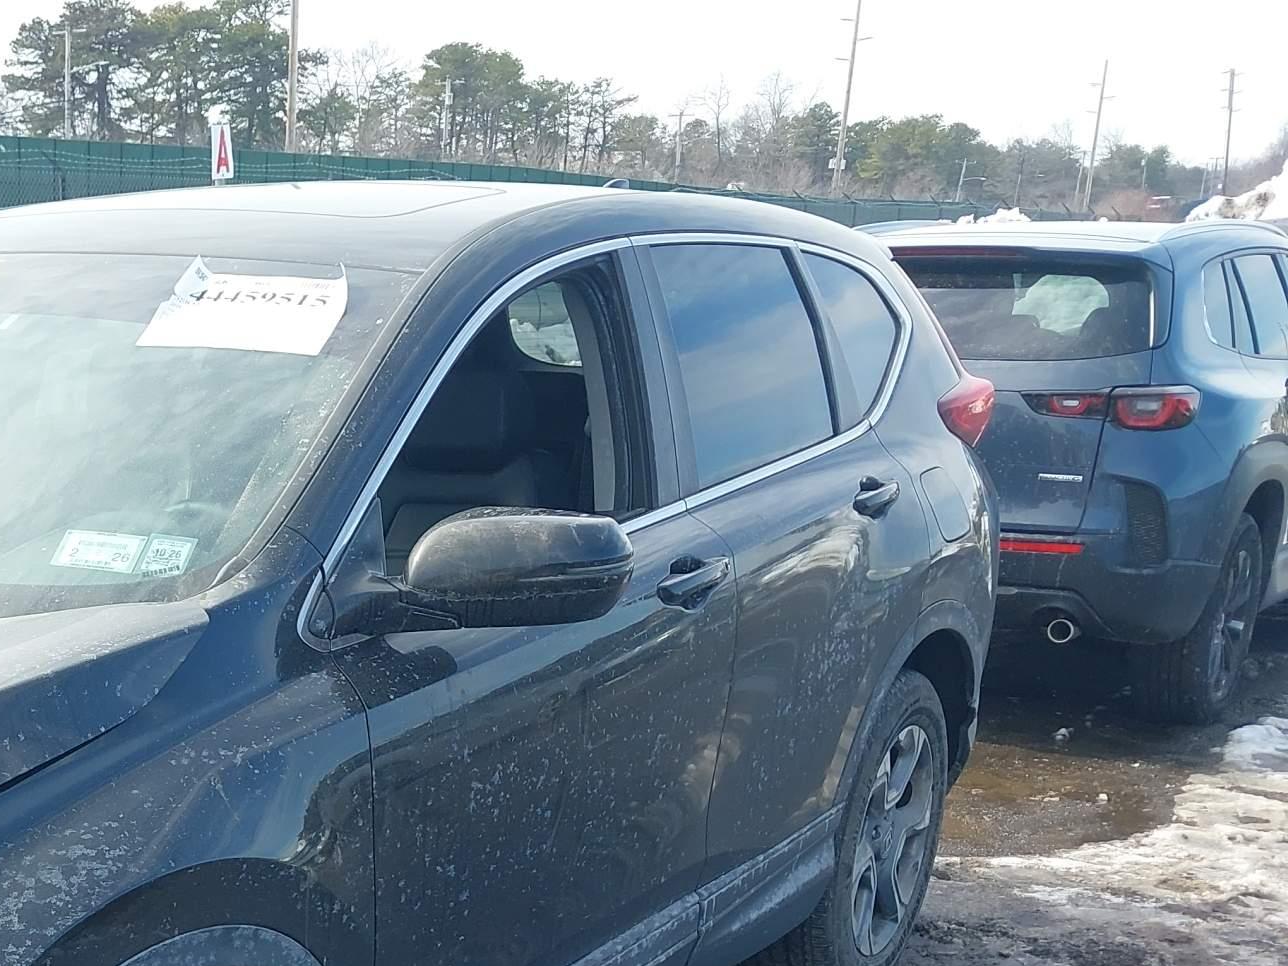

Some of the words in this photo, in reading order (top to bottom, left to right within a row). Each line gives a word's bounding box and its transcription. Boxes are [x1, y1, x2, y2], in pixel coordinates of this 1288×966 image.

[216, 126, 230, 174] A
[189, 289, 331, 307] 44459515
[111, 552, 131, 563] 26
